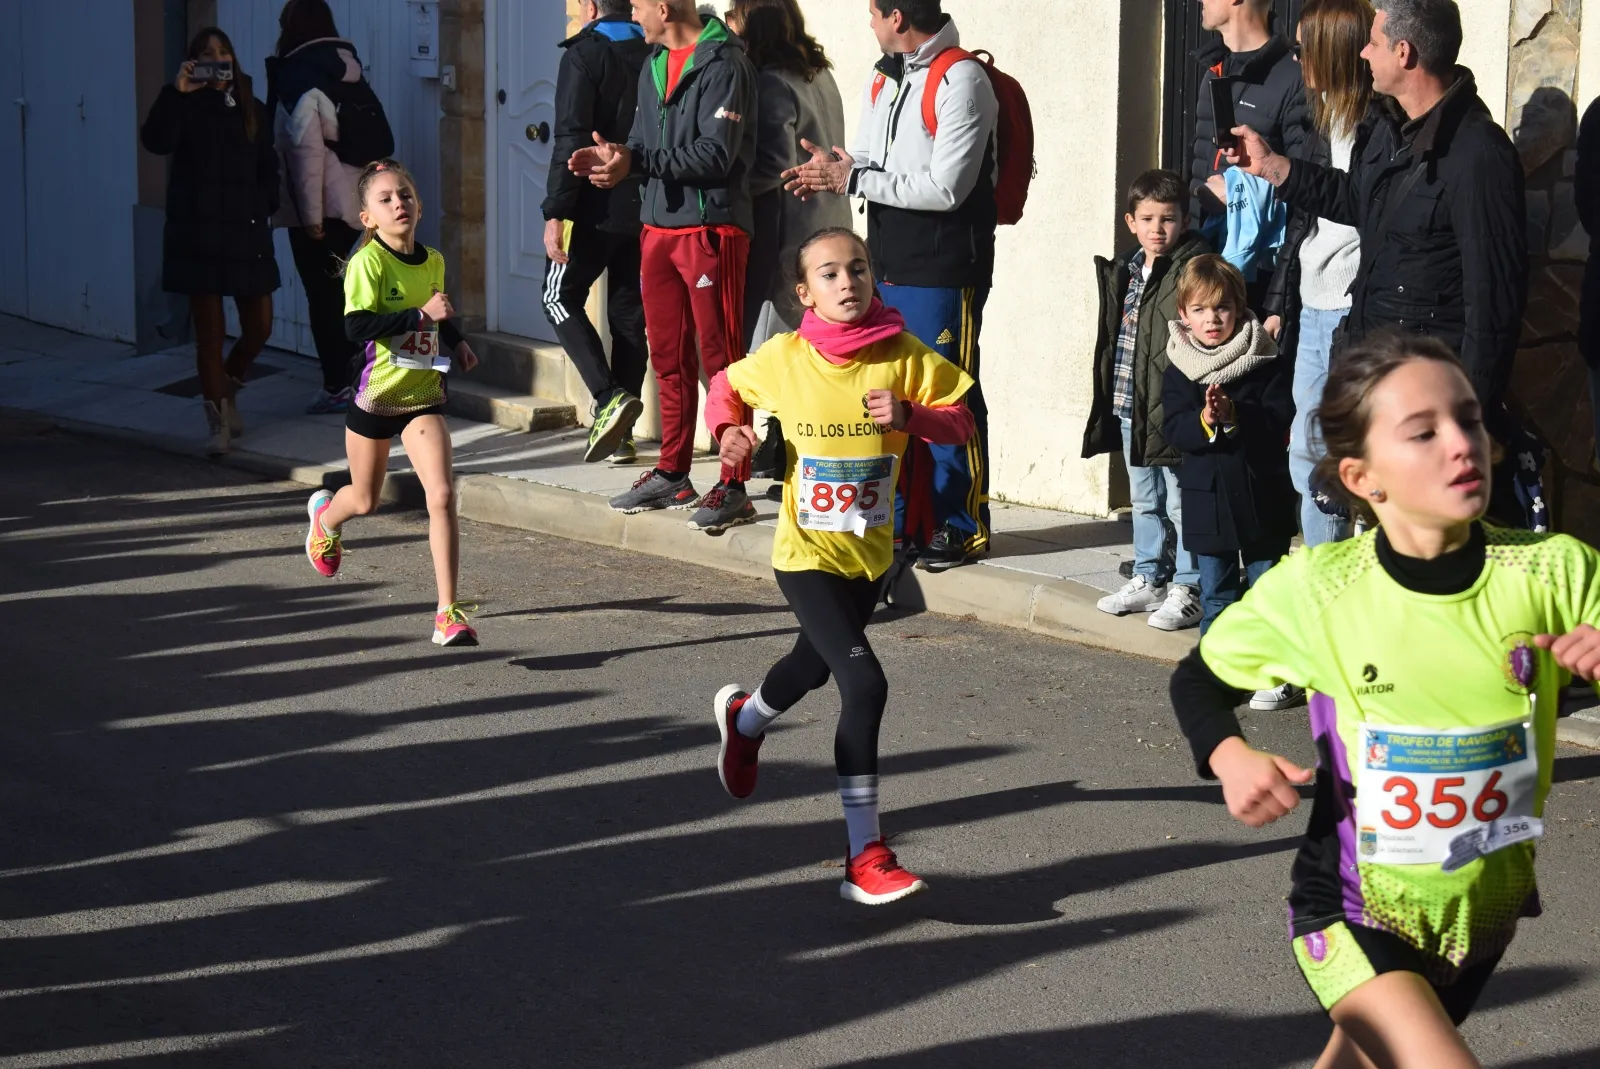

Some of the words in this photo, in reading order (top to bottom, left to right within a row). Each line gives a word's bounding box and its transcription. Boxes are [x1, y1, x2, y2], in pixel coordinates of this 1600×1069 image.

[797, 422, 817, 437] C.D.
[820, 423, 845, 438] LOS
[815, 461, 843, 469] TROFEO
[810, 481, 881, 513] 895
[873, 514, 886, 522] 895
[1386, 734, 1434, 748] TROFEO
[1436, 735, 1454, 748] DE
[1457, 729, 1508, 747] NAVIDAD
[1381, 770, 1508, 830] 356
[1503, 821, 1530, 836] 356
